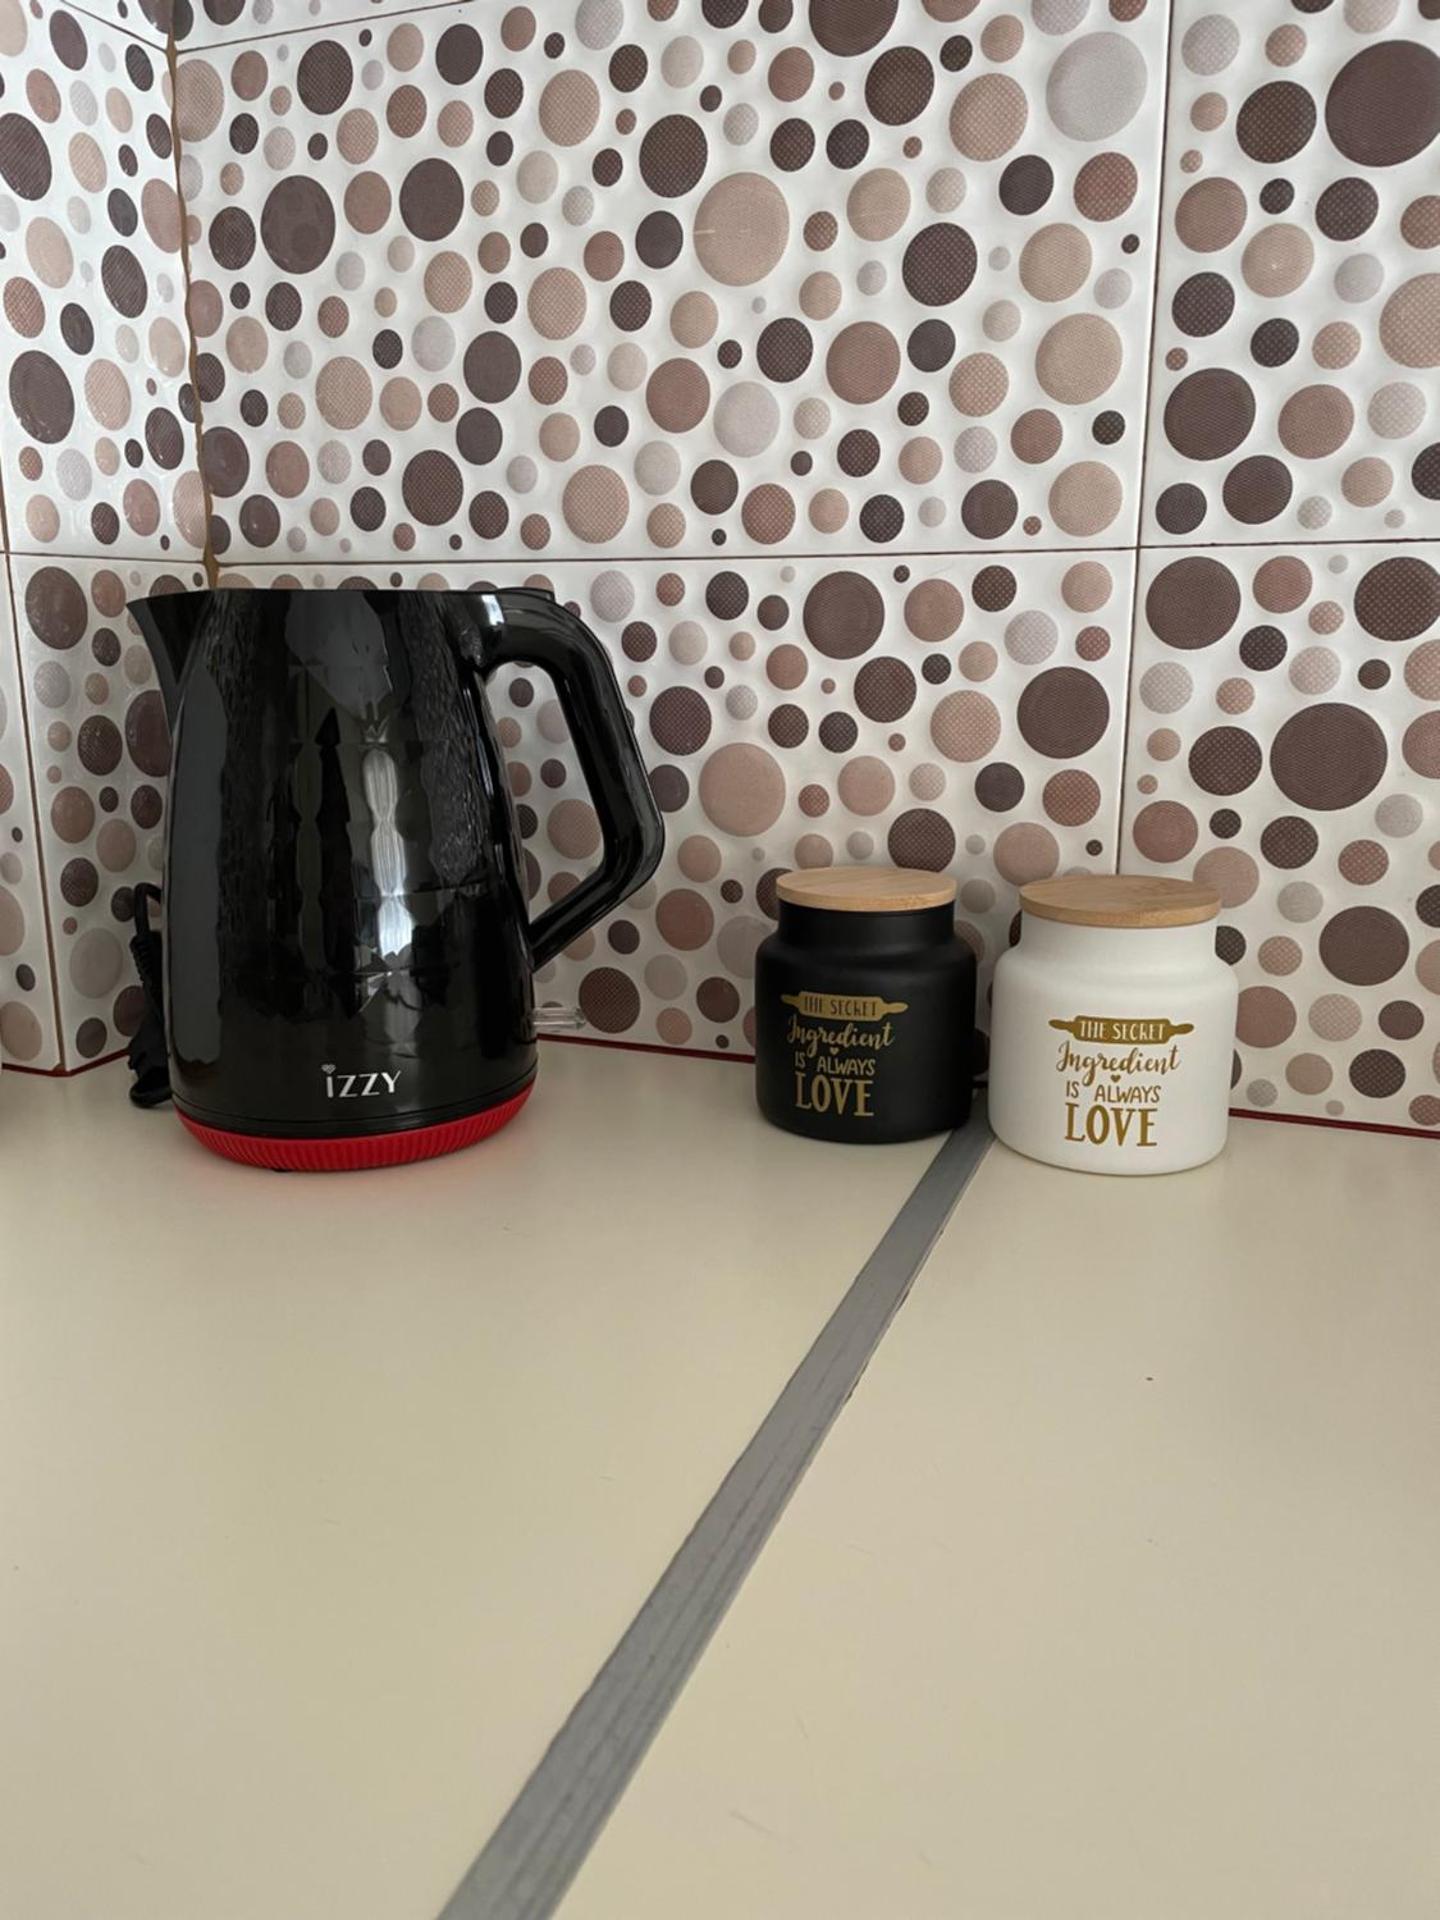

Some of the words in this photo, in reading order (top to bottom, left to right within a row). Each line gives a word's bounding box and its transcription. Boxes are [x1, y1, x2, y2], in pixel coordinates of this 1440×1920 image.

[830, 1000, 877, 1017] SECRET
[787, 1014, 893, 1058] Ingredient
[1080, 1020, 1106, 1039] THE
[1112, 1022, 1166, 1041] SECRET
[795, 1051, 806, 1069] IS
[817, 1056, 876, 1076] ALWAYS
[1056, 1040, 1180, 1087] Ingredient
[795, 1071, 874, 1117] LOVE
[1066, 1080, 1080, 1099] IS
[1094, 1084, 1162, 1104] ALWAYS
[1064, 1102, 1158, 1147] LOVE
